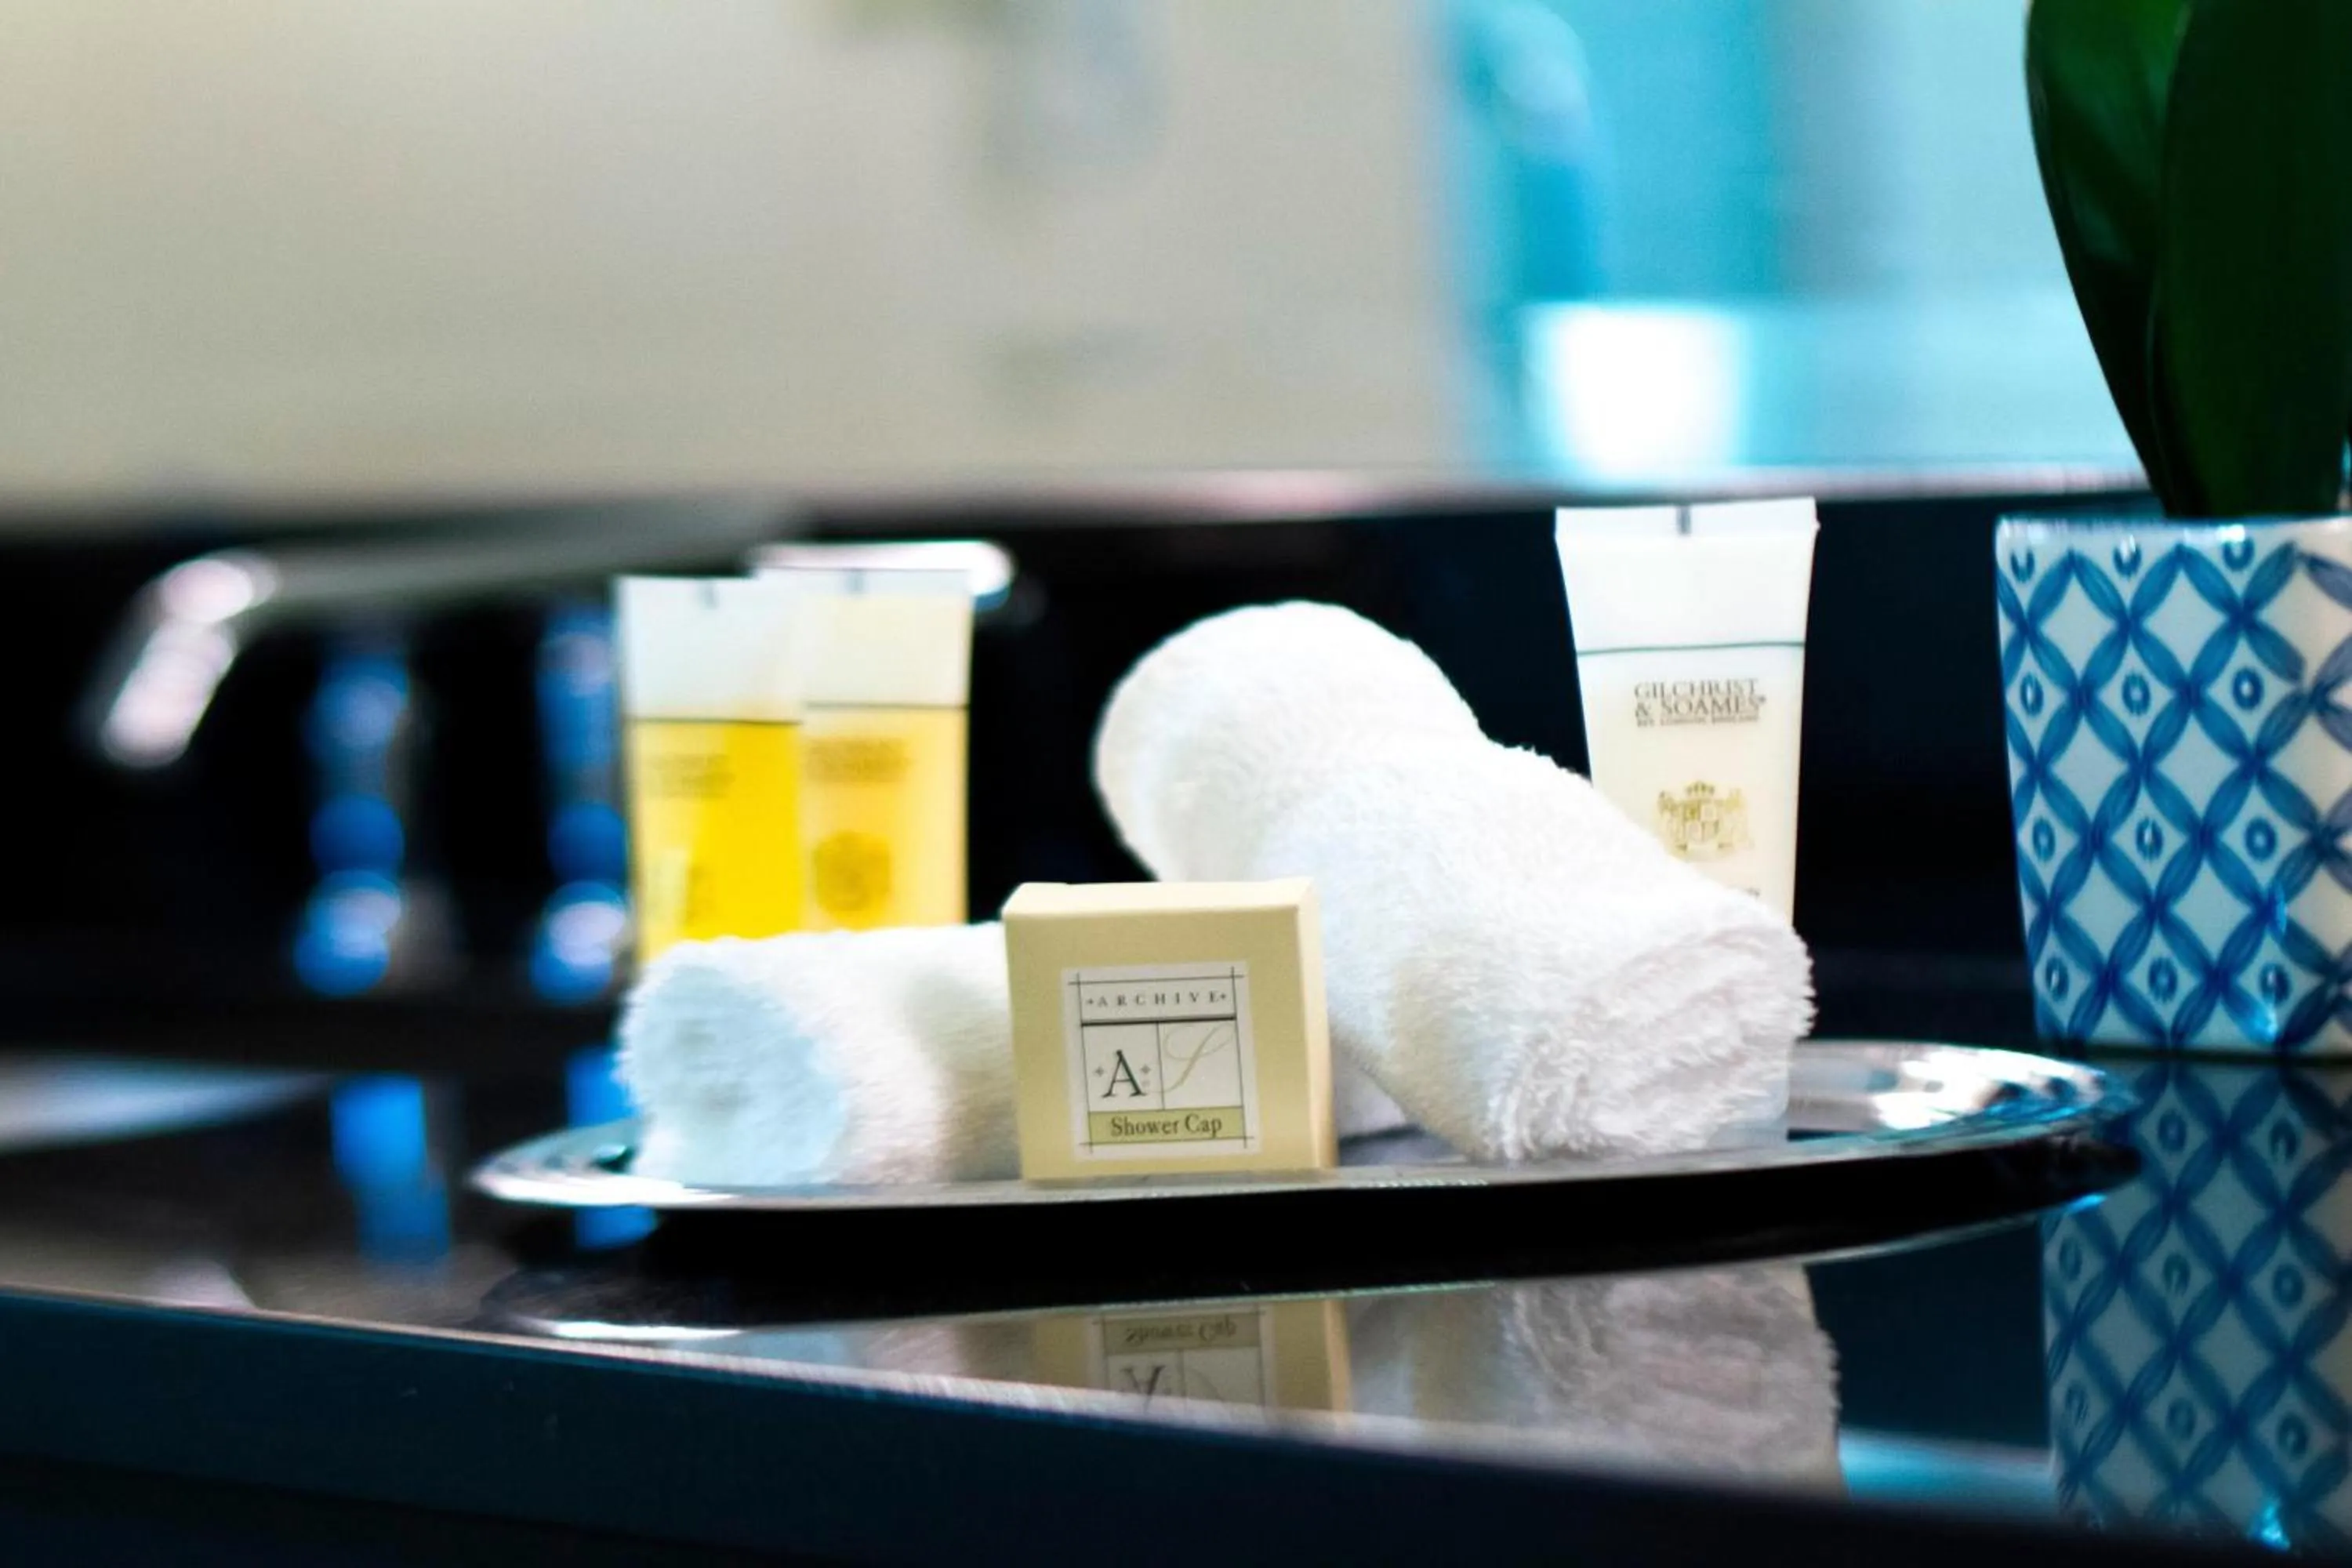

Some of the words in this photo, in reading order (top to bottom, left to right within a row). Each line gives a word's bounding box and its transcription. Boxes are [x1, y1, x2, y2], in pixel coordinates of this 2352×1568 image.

[1634, 678, 1759, 699] GILCHRIST
[1634, 702, 1649, 718] &
[1661, 694, 1760, 717] SOAMES
[1098, 991, 1219, 1007] ARCHIVE
[1102, 1049, 1148, 1098] A
[1110, 1116, 1179, 1137] Shower
[1184, 1112, 1222, 1138] Cap
